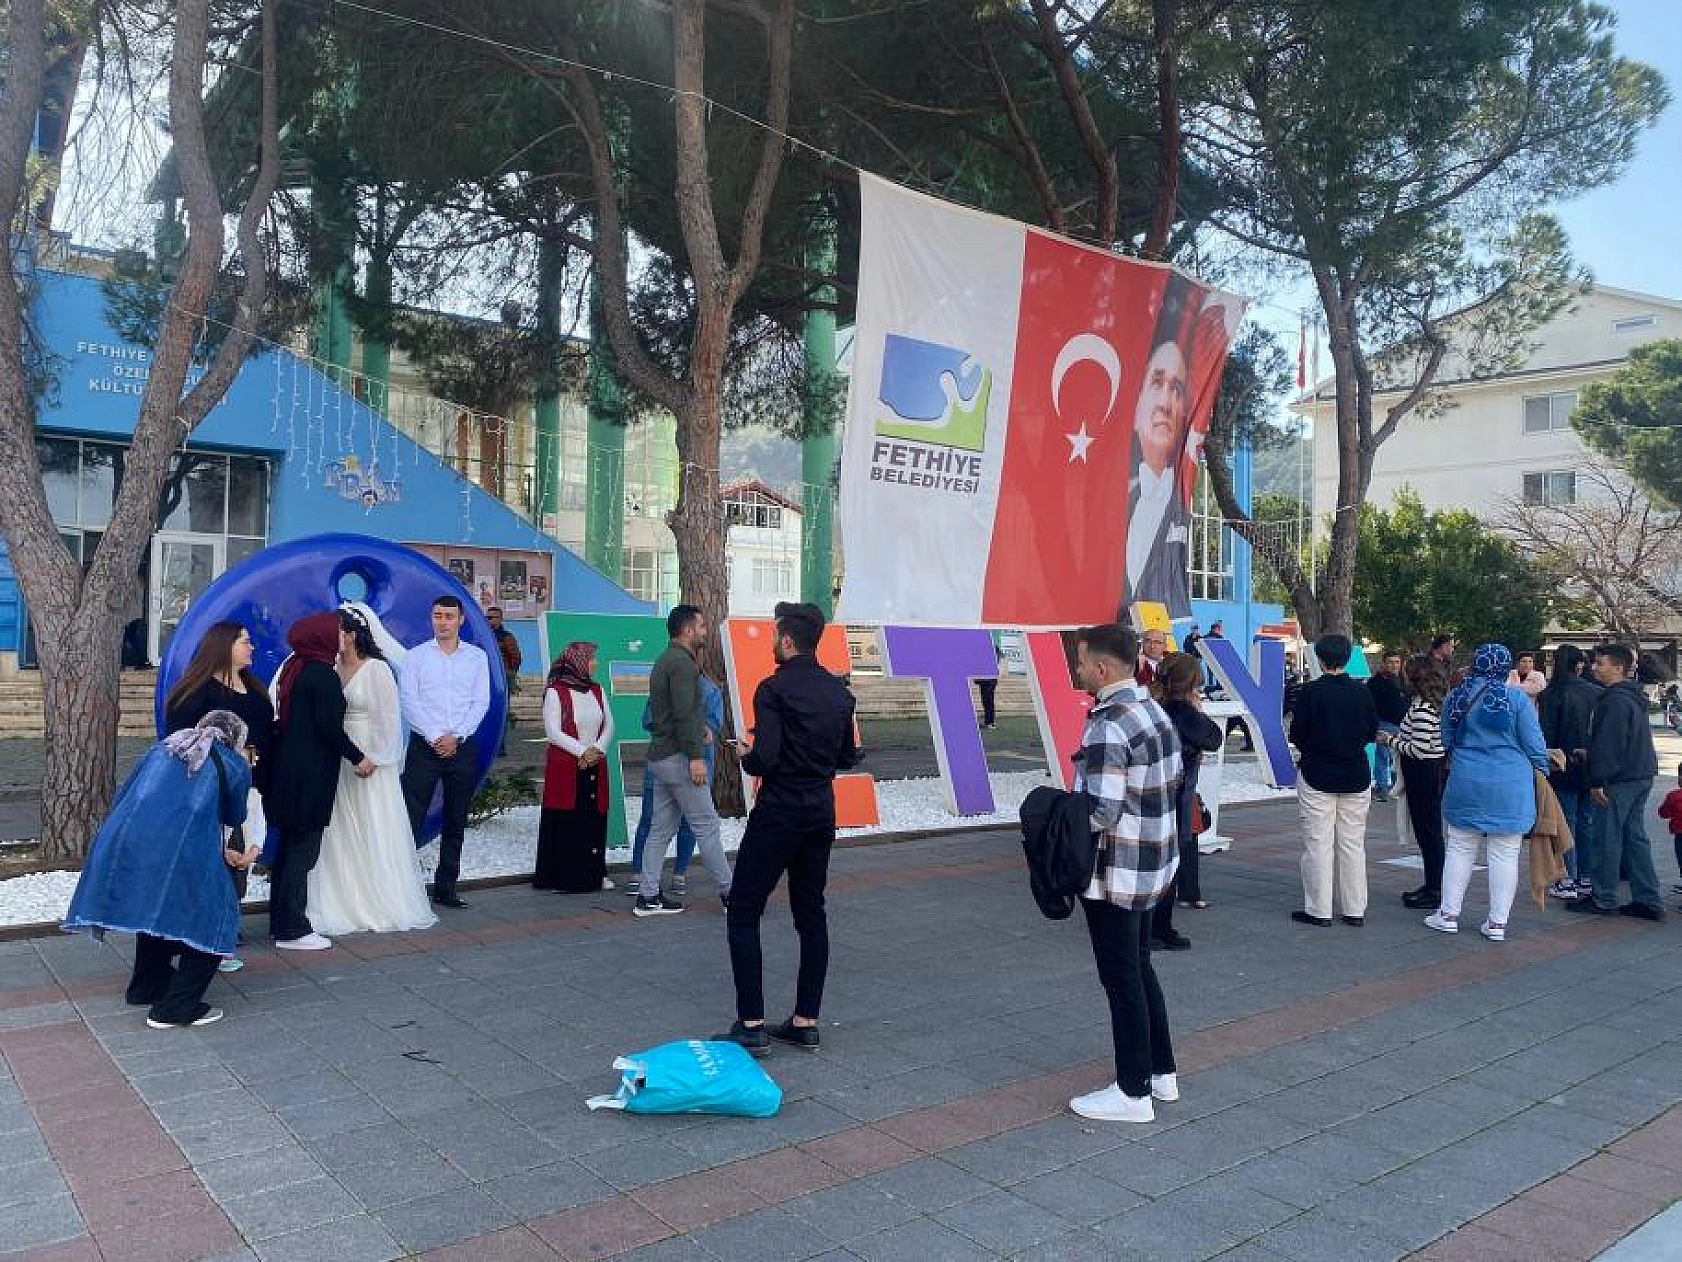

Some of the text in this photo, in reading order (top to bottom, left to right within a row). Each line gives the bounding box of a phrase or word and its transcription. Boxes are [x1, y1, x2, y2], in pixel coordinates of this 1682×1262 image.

[88, 377, 143, 395] KÜLTÜ
[871, 441, 982, 477] FETHİYE
[869, 466, 980, 494] BELEDİYESİ
